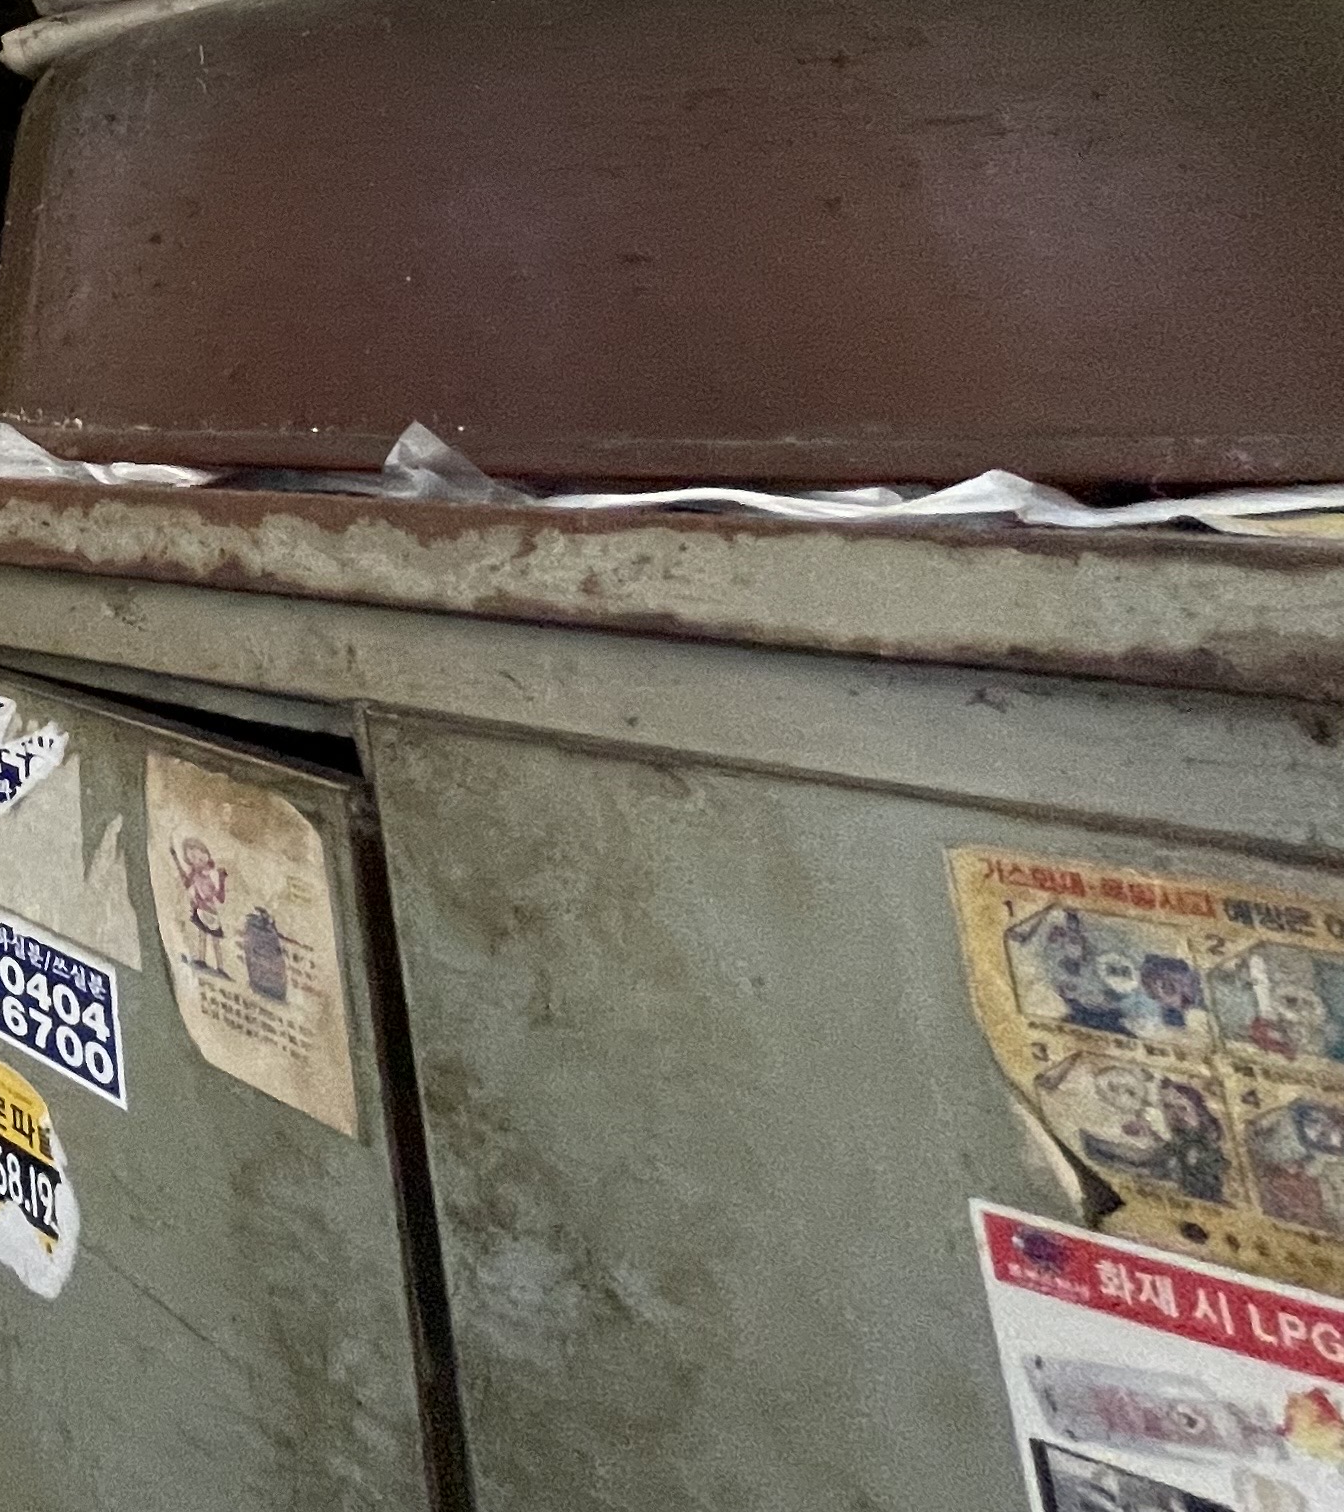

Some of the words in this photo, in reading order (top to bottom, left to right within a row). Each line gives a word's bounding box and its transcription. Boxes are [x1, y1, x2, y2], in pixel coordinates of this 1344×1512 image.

[1094, 1259, 1180, 1319] 화재
[1195, 1287, 1235, 1337] 시
[1248, 1293, 1344, 1364] LPG
